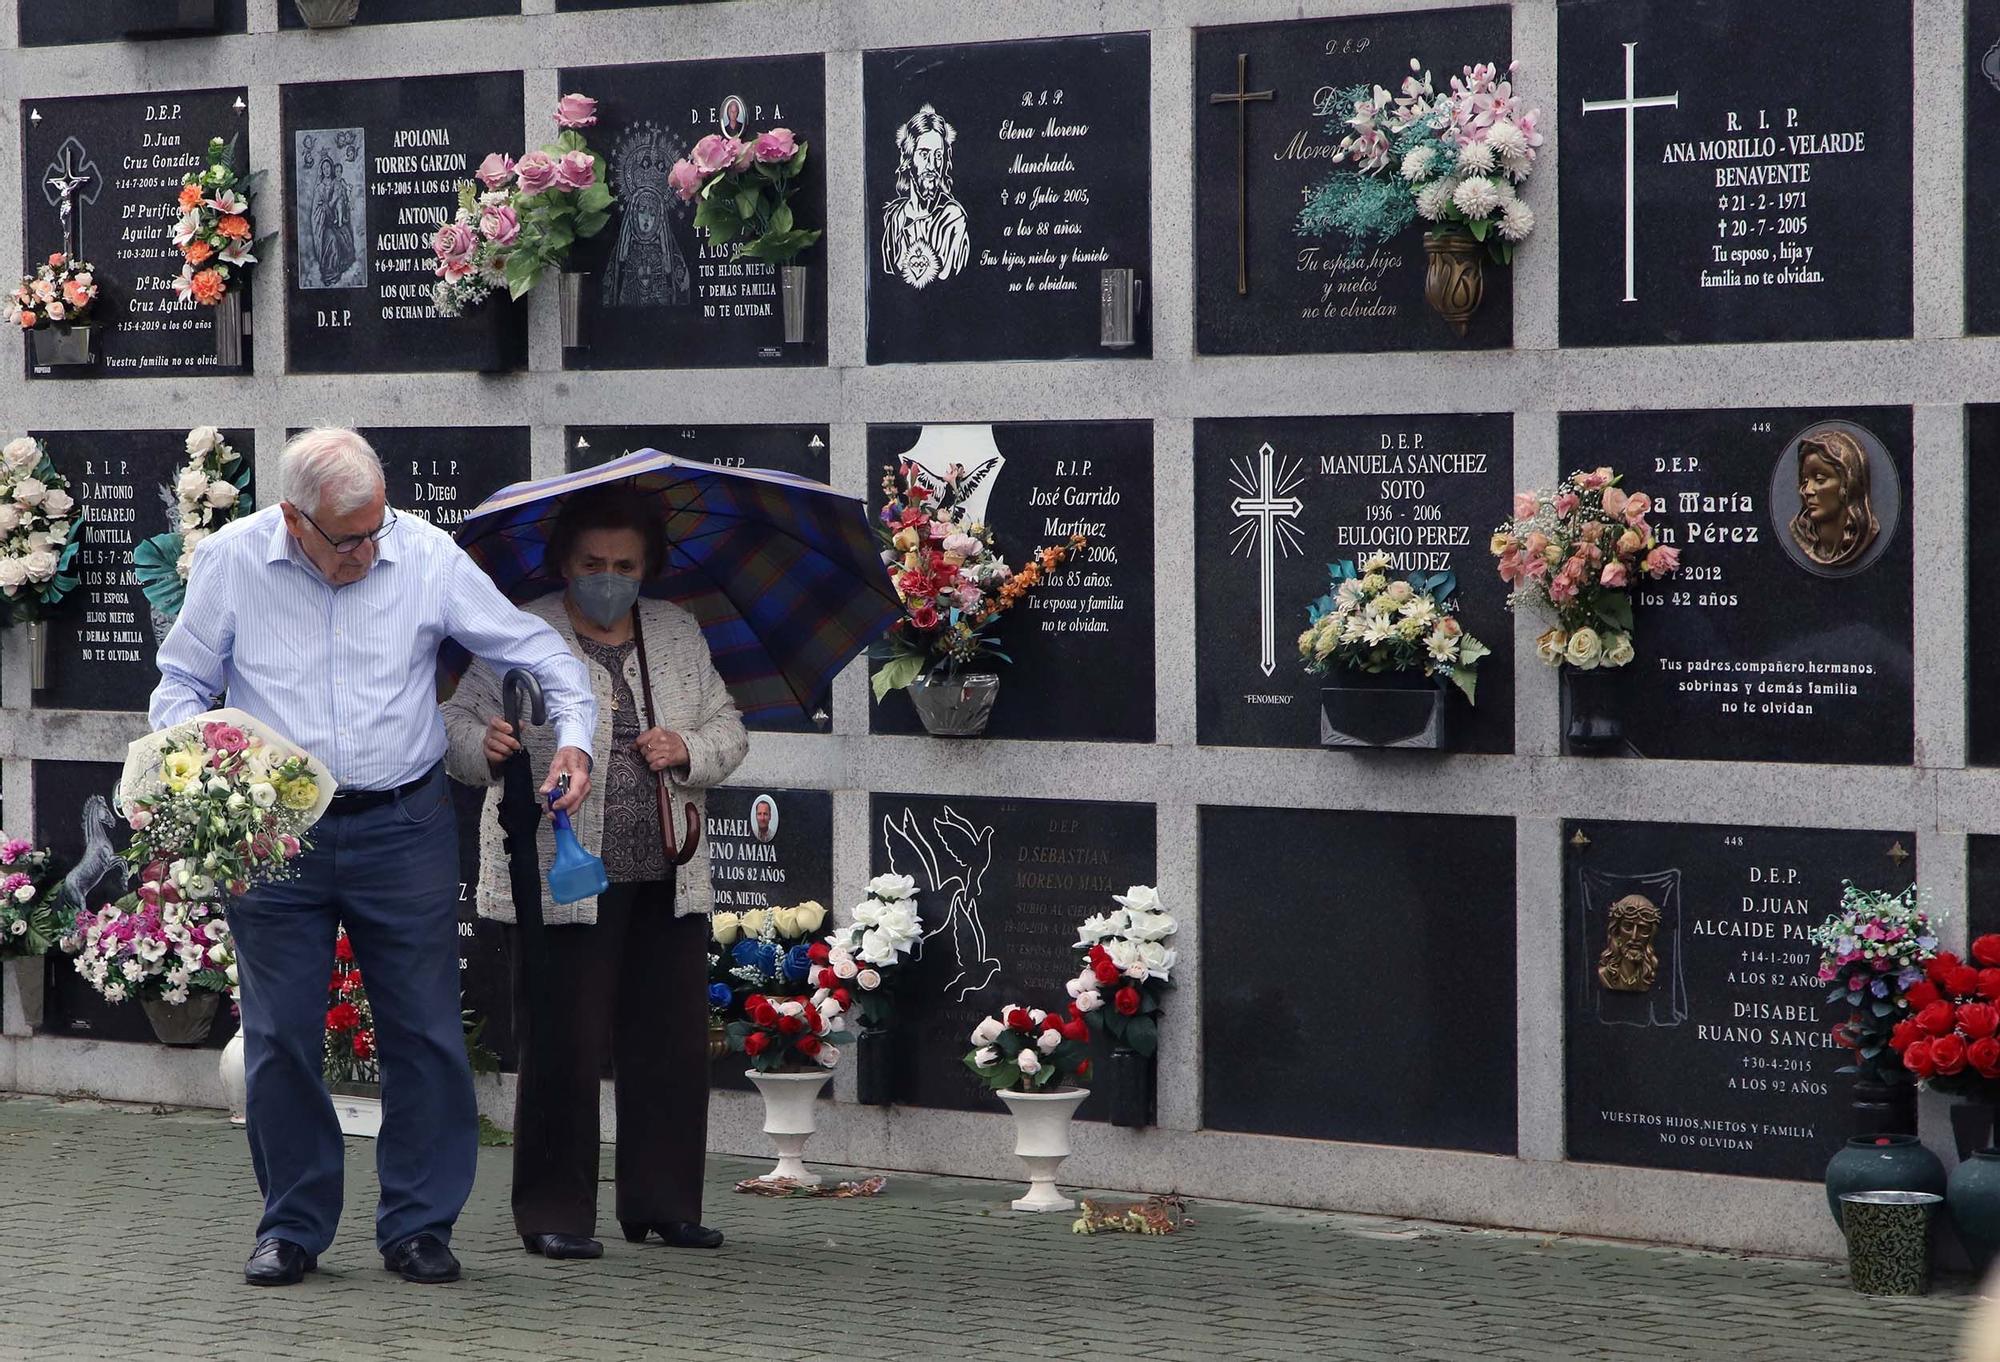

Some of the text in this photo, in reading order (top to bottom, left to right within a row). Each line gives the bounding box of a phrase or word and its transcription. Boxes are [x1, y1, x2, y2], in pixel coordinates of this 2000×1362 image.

[1727, 108, 1797, 131] R. I. P.
[999, 118, 1089, 139] Elena Moreno
[394, 129, 449, 147] APOLONIA
[124, 153, 200, 169] Cruz González
[1663, 143, 1696, 163] ANA
[375, 154, 466, 173] TORRES GARZON
[1009, 153, 1074, 173] Manchado.
[168, 178, 179, 187] los
[1716, 163, 1810, 187] BENAVENTE
[422, 180, 449, 193] LOS 63
[1015, 186, 1089, 210] 19 Julio 2005,
[398, 207, 448, 225] ANTONIO
[122, 225, 162, 242] Aguilar
[1004, 219, 1081, 236] a los 88 años.
[377, 233, 418, 250] AGUAYO
[710, 244, 728, 258] LOS
[980, 247, 1109, 271] Tus hijos, nietos y bisnieto
[1712, 245, 1727, 262] Tu
[1780, 242, 1802, 264] hija
[1805, 247, 1813, 263] y
[1297, 248, 1319, 271] Tu
[699, 265, 714, 277] TUS
[1701, 266, 1824, 287] familia no te olvidan.
[699, 283, 776, 297] Y DEMAS FAMILIA
[1009, 275, 1077, 291] no olvidan.
[1321, 276, 1377, 302] y nietos
[381, 285, 429, 300] LOS QUE OS
[130, 299, 153, 312] Cruz
[382, 307, 394, 320] OS
[396, 306, 423, 319] ECHAN
[704, 304, 773, 317] NO TE OLVIDAN.
[1301, 296, 1396, 318] no te olvidan
[169, 320, 211, 329] los 60 años
[107, 356, 194, 368] Vuestra familia no os
[681, 430, 695, 438] 442
[1752, 423, 1770, 432] 448
[1321, 454, 1487, 474] MANUELA SANCHEZ
[1029, 486, 1119, 505] José Garrido
[1381, 480, 1424, 499] SOTO
[1679, 492, 1752, 512] María
[1367, 505, 1441, 520] 1936 2006
[1044, 518, 1106, 538] Martínez
[1338, 526, 1469, 545] EULOGIO PEREZ
[1688, 523, 1758, 542] Pérez
[83, 551, 94, 564] EL
[87, 572, 116, 585] LOS 58
[1048, 571, 1112, 586] los 85 años.
[91, 593, 129, 603] TU ESPOSA
[1028, 595, 1123, 613] Tu esposa familia
[1641, 592, 1737, 605] los 42 años
[87, 612, 134, 623] HIJOS NIETOS
[1042, 618, 1108, 631] no te olvidan.
[87, 631, 143, 643] DEMAS FAMILIA
[83, 649, 141, 661] NO TE OLVIDAN.
[1660, 659, 1681, 670] Tus
[1679, 680, 1857, 694] sobrinas demás familia
[1722, 702, 1812, 714] no te olvidan
[708, 819, 750, 836] RAFAEL
[1724, 837, 1743, 846] 448
[738, 843, 776, 862] AMAYA
[727, 866, 785, 882] LOS 82 AÑOS
[737, 892, 769, 907] NIETOS,
[1694, 920, 1774, 938] ALCAIDE
[1741, 972, 1784, 985] LOS 82
[1699, 1025, 1761, 1043] RUANO
[1742, 1078, 1827, 1094] LOS 92 AÑOS
[1602, 1111, 1814, 1138] VUESTROS FAMILIA
[1660, 1133, 1752, 1149] NO OS OLVIDAN
